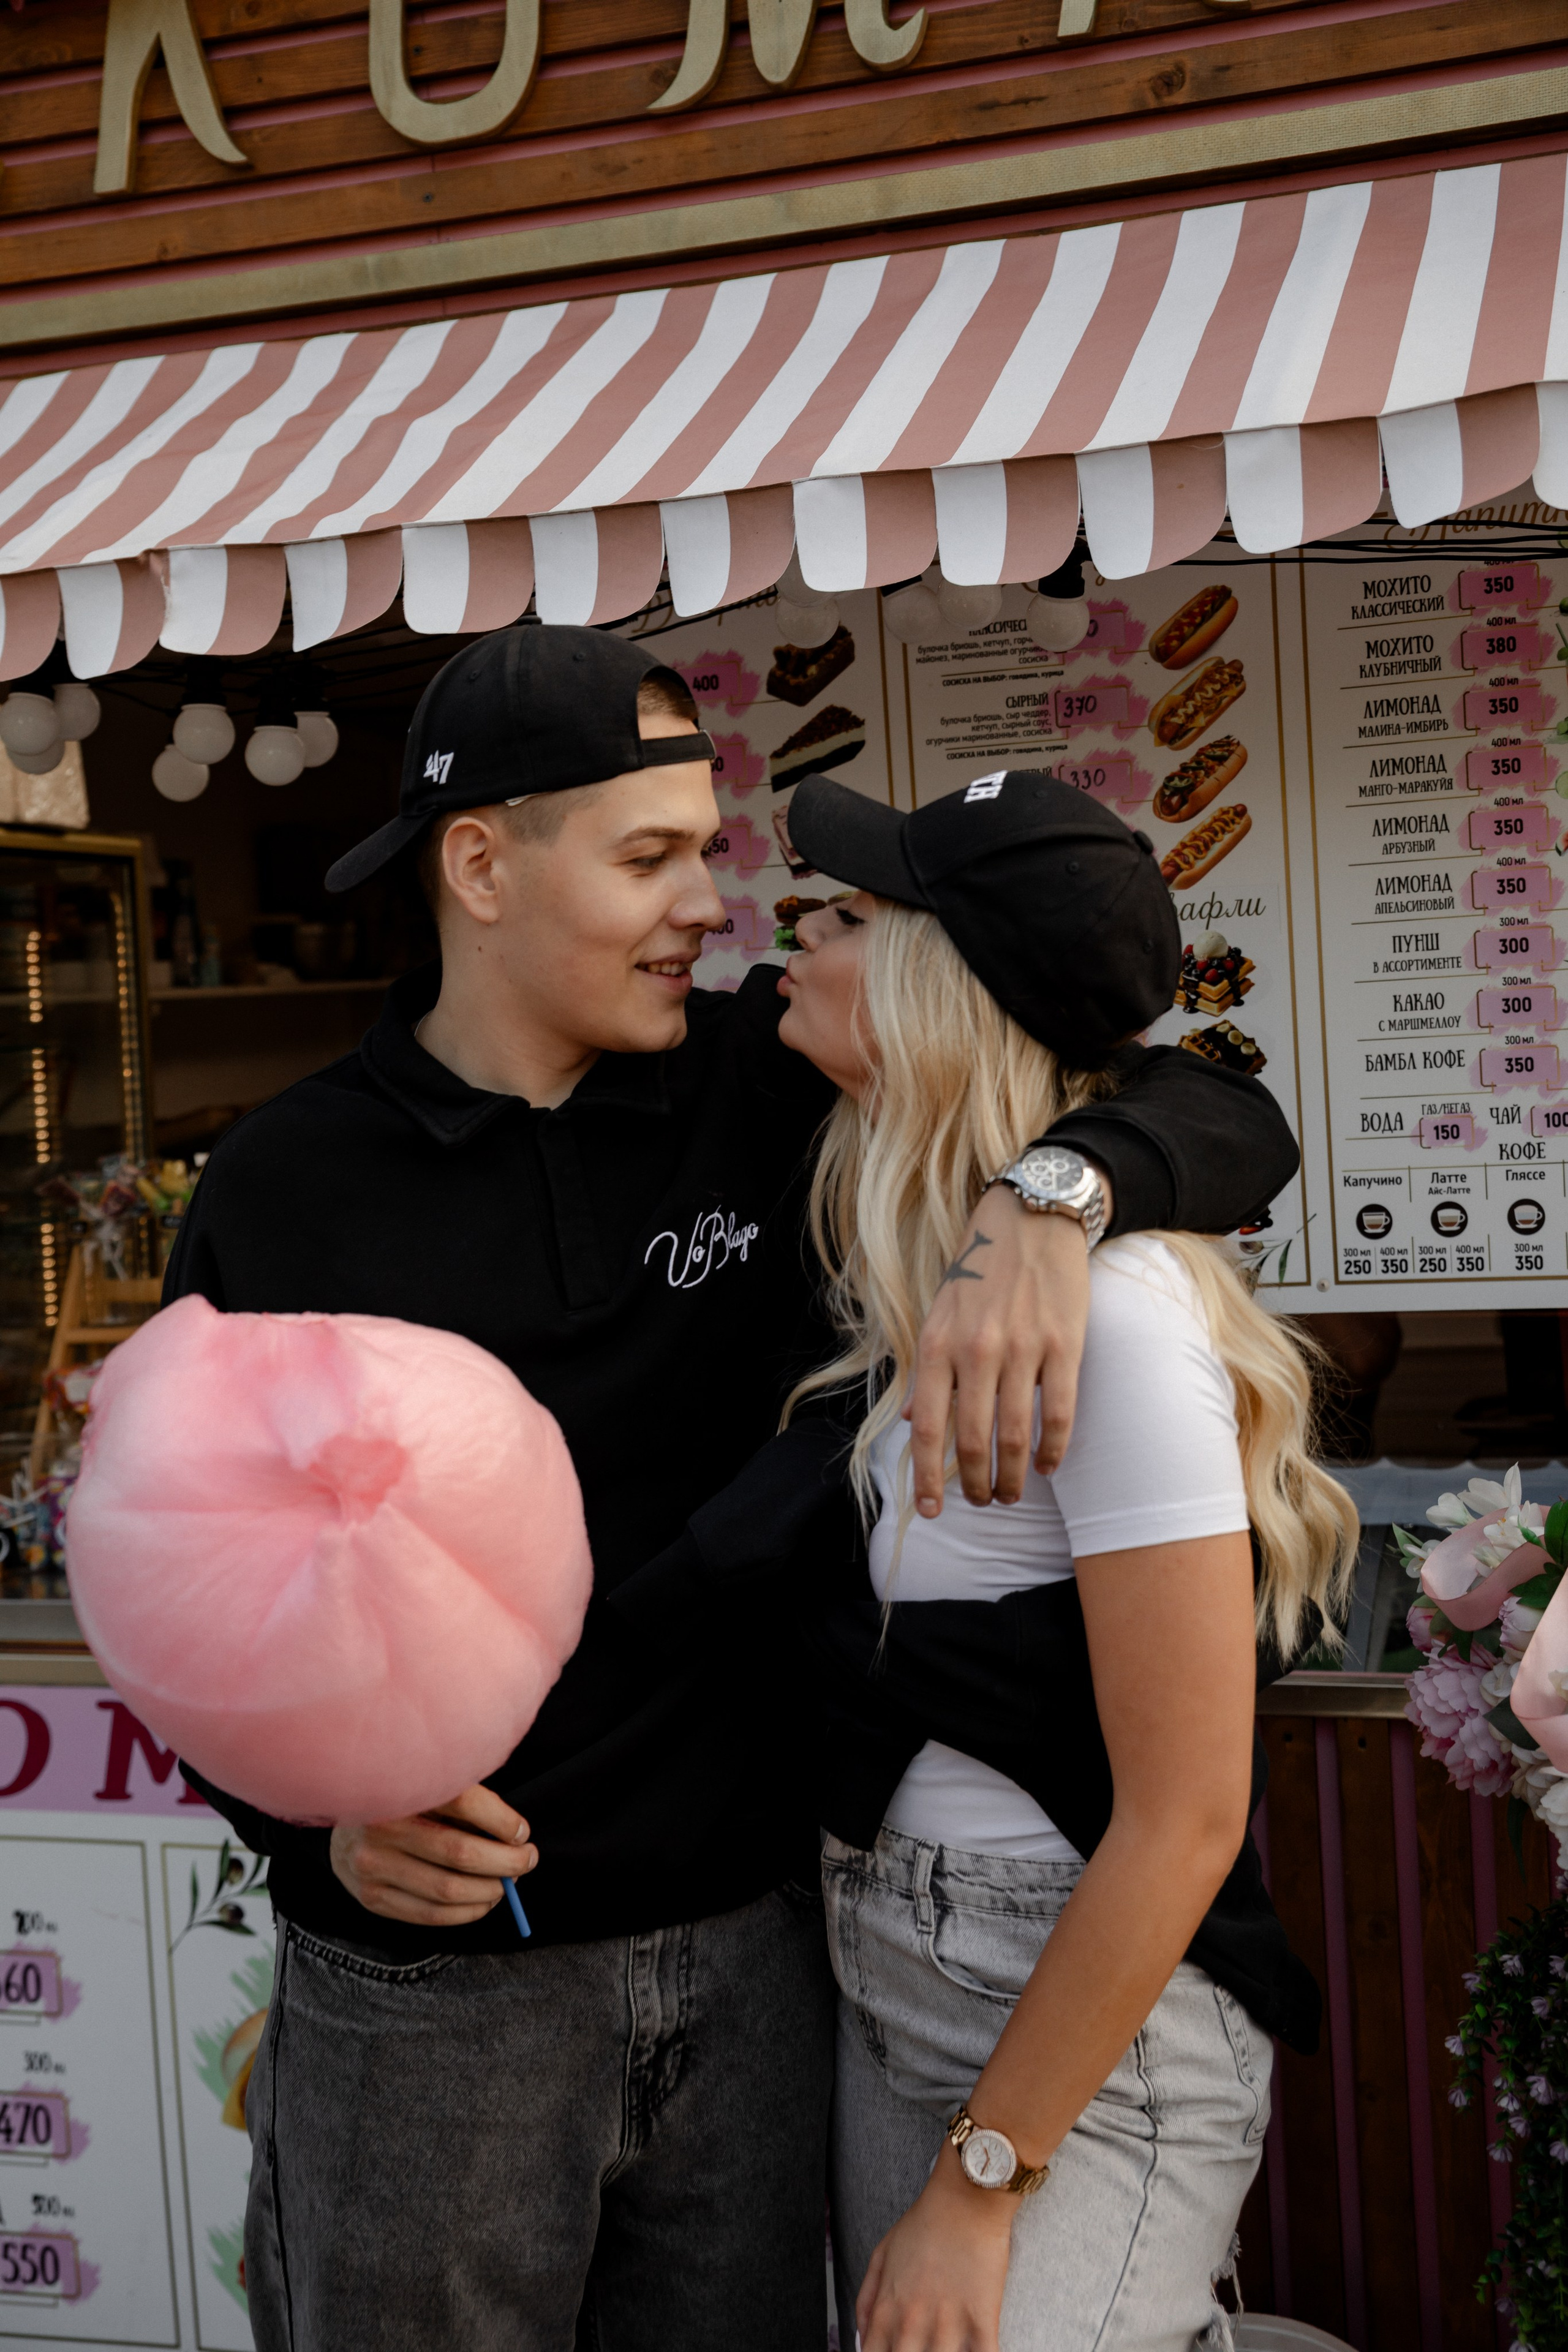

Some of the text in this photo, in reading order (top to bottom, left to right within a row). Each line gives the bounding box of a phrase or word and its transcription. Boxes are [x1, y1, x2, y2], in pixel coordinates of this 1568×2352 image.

[1363, 575, 1431, 601] МОХИТО
[1484, 576, 1513, 594] 350
[1351, 594, 1444, 620] КЛАССИЧЕСКИЙ
[1487, 617, 1503, 627] 400
[1365, 635, 1434, 661] МОХИТО
[1487, 636, 1516, 654] 380
[1019, 655, 1049, 663] сосиска
[1360, 654, 1441, 679] КЛУБНИЧНЫЙ
[693, 674, 719, 692] 400
[1489, 677, 1506, 687] 400
[1006, 692, 1049, 708] СЫРНЫЙ
[1063, 695, 1097, 718] 370
[1364, 695, 1441, 718] ЛИМОНАД
[1489, 697, 1518, 714] 350
[1359, 719, 1449, 739] МАЛИНА-ИМБИРЬ
[1491, 737, 1507, 747] 400
[423, 749, 454, 785] 47
[1370, 754, 1447, 777] ЛИМОНАД
[1491, 758, 1521, 775] 350
[1359, 778, 1453, 797] МАНГО-МАРАКУЙЯ
[1373, 814, 1449, 837] ЛИМОНАД
[1494, 818, 1523, 835] 350
[708, 839, 729, 853] 50
[1382, 839, 1435, 854] АРБУЗНЫЙ
[1497, 857, 1513, 866] 400
[1376, 873, 1452, 895] ЛИМОНАД
[1497, 878, 1526, 894] 350
[1375, 897, 1454, 914] АПЕЛЬСИНОВЫЙ
[1500, 917, 1515, 926] 300
[1393, 933, 1439, 953] ПУНШ
[1499, 937, 1529, 954] 300
[1373, 957, 1461, 973] В АССОРТИМЕНТЕ
[1502, 976, 1518, 986] 300
[1393, 992, 1444, 1012] КАКАО
[1502, 997, 1531, 1013] 300
[1379, 1016, 1461, 1031] С МАРШМЕЛЛОУ
[1506, 1036, 1521, 1044] 300
[1366, 1050, 1464, 1071] БАМБЛ КОФЕ
[1506, 1057, 1534, 1073] 350
[1422, 1102, 1470, 1115] ГАЗ/НЕГАЗ
[1490, 1104, 1521, 1125] ЧАЙ
[1361, 1112, 1403, 1133] ВОДА
[1545, 1112, 1568, 1128] 100
[1434, 1125, 1460, 1140] 150
[1499, 1142, 1545, 1159] КОФЕ
[1344, 1176, 1402, 1189] Капучино
[1431, 1172, 1466, 1183] Латте
[1506, 1170, 1545, 1181] Гляссе
[1344, 1248, 1358, 1257] 300
[1380, 1247, 1395, 1256] 400
[1419, 1246, 1433, 1254] 300
[1456, 1245, 1471, 1254] 400
[1515, 1243, 1529, 1252] 300
[1345, 1260, 1371, 1275] 250
[1381, 1259, 1408, 1273] 350
[1420, 1257, 1446, 1272] 250
[1457, 1257, 1484, 1272] 350
[1516, 1255, 1543, 1270] 350
[0, 1963, 41, 2003] 60
